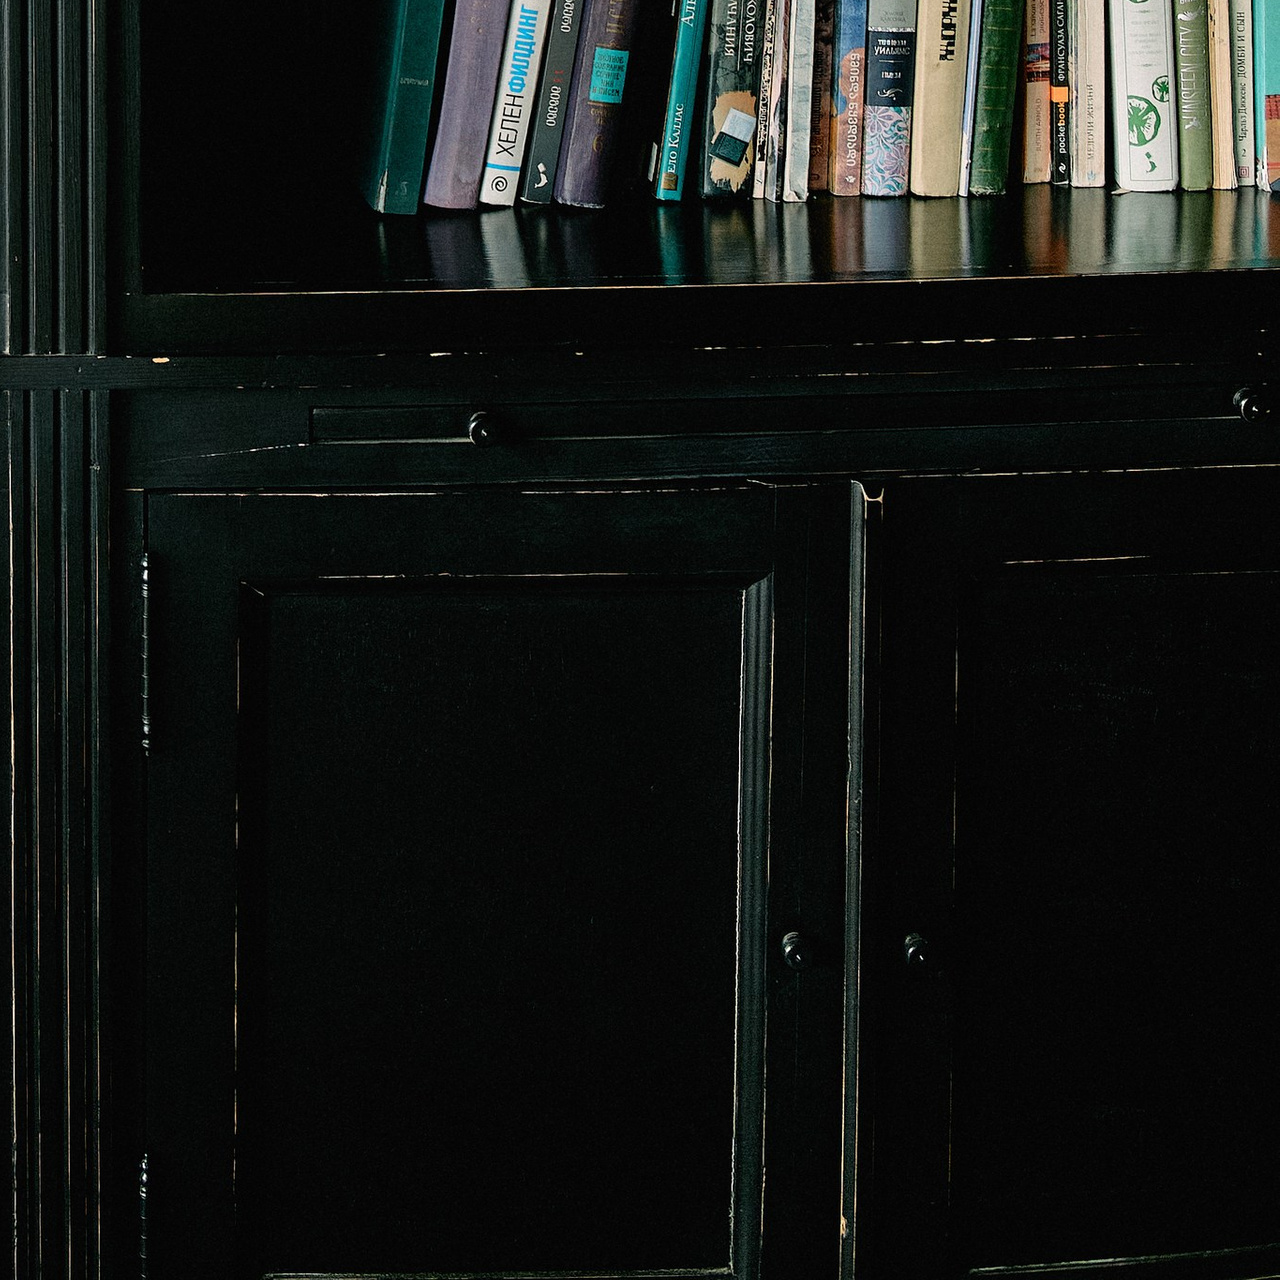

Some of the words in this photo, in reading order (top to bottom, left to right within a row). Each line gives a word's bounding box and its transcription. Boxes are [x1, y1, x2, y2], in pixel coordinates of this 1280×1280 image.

[507, 3, 541, 94] ФИЛДИНГ
[1055, 27, 1065, 81] ФРАНСУАЗА
[495, 93, 523, 157] ХЕЛЕН
[1057, 101, 1067, 153] pocketbook
